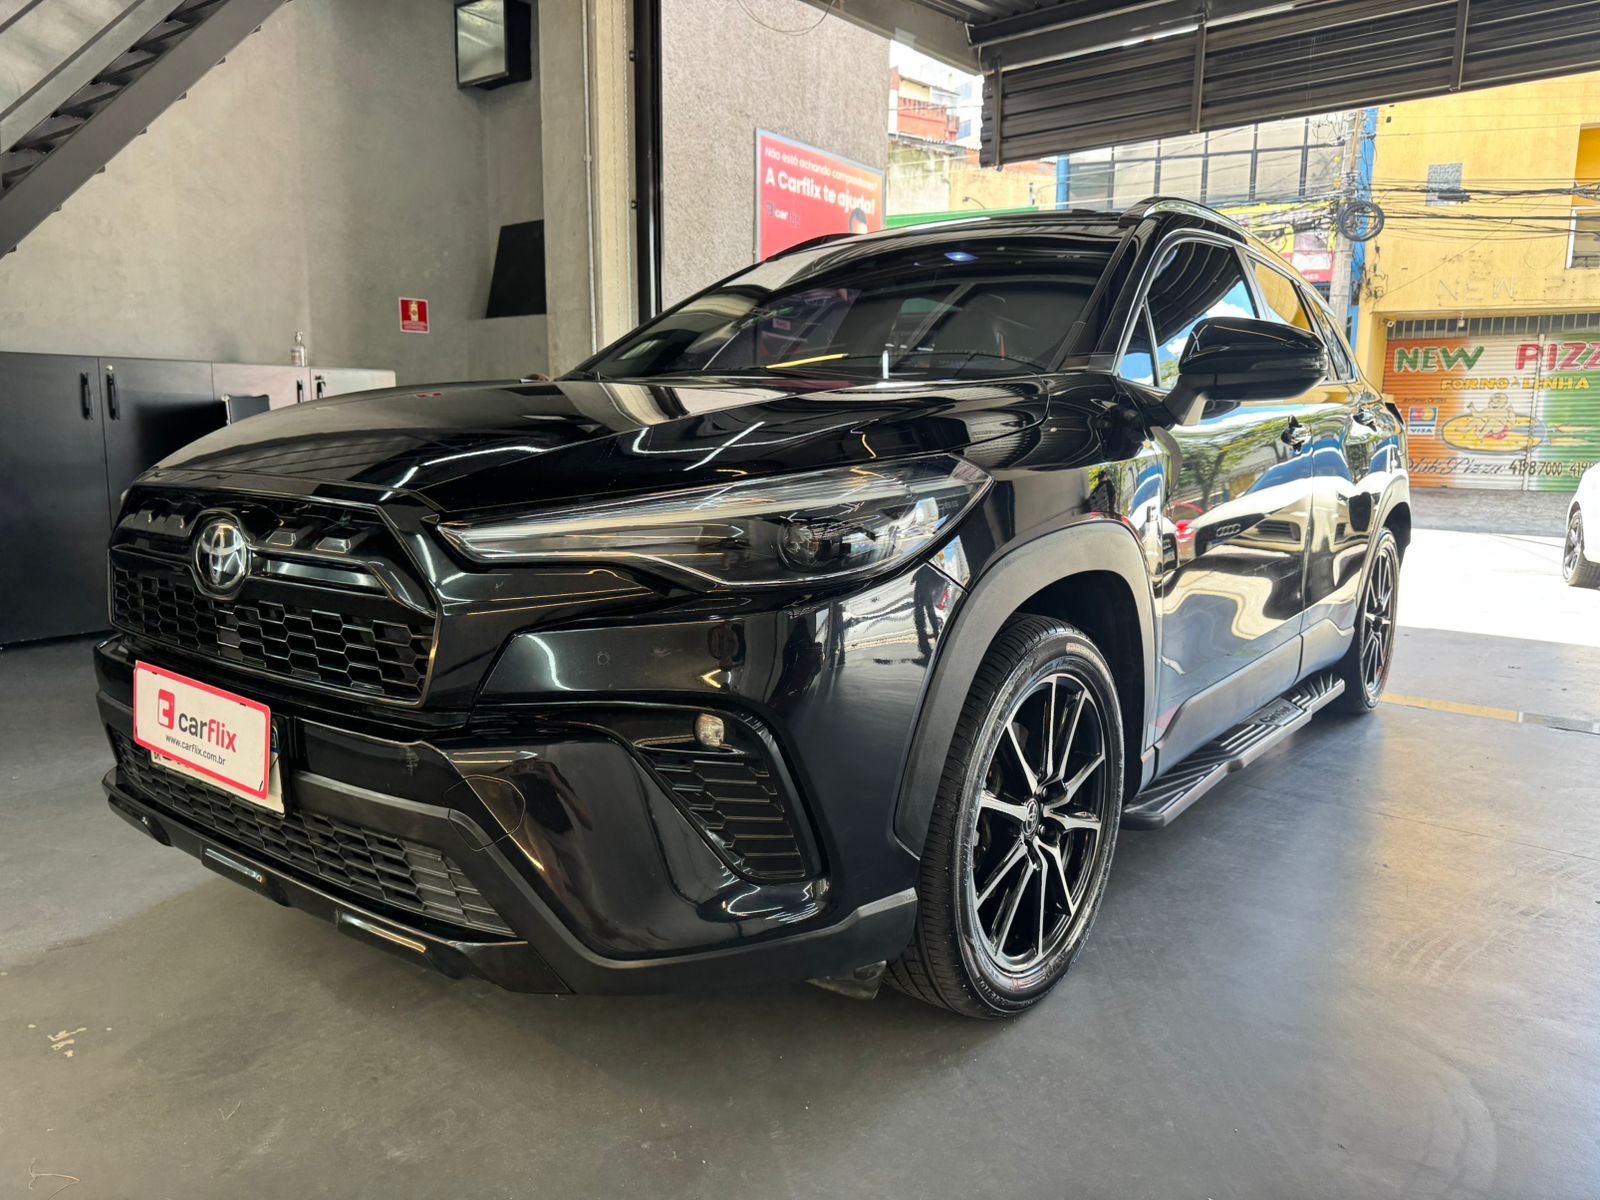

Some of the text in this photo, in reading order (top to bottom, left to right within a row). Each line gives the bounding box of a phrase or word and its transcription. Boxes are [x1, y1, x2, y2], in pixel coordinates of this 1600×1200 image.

[765, 168, 876, 215] A Carflix te ajuda!
[1394, 345, 1485, 374] NEW
[1440, 377, 1509, 391] FORNO
[178, 712, 238, 753] carflix
[165, 734, 227, 766] www.carflix.com.br
